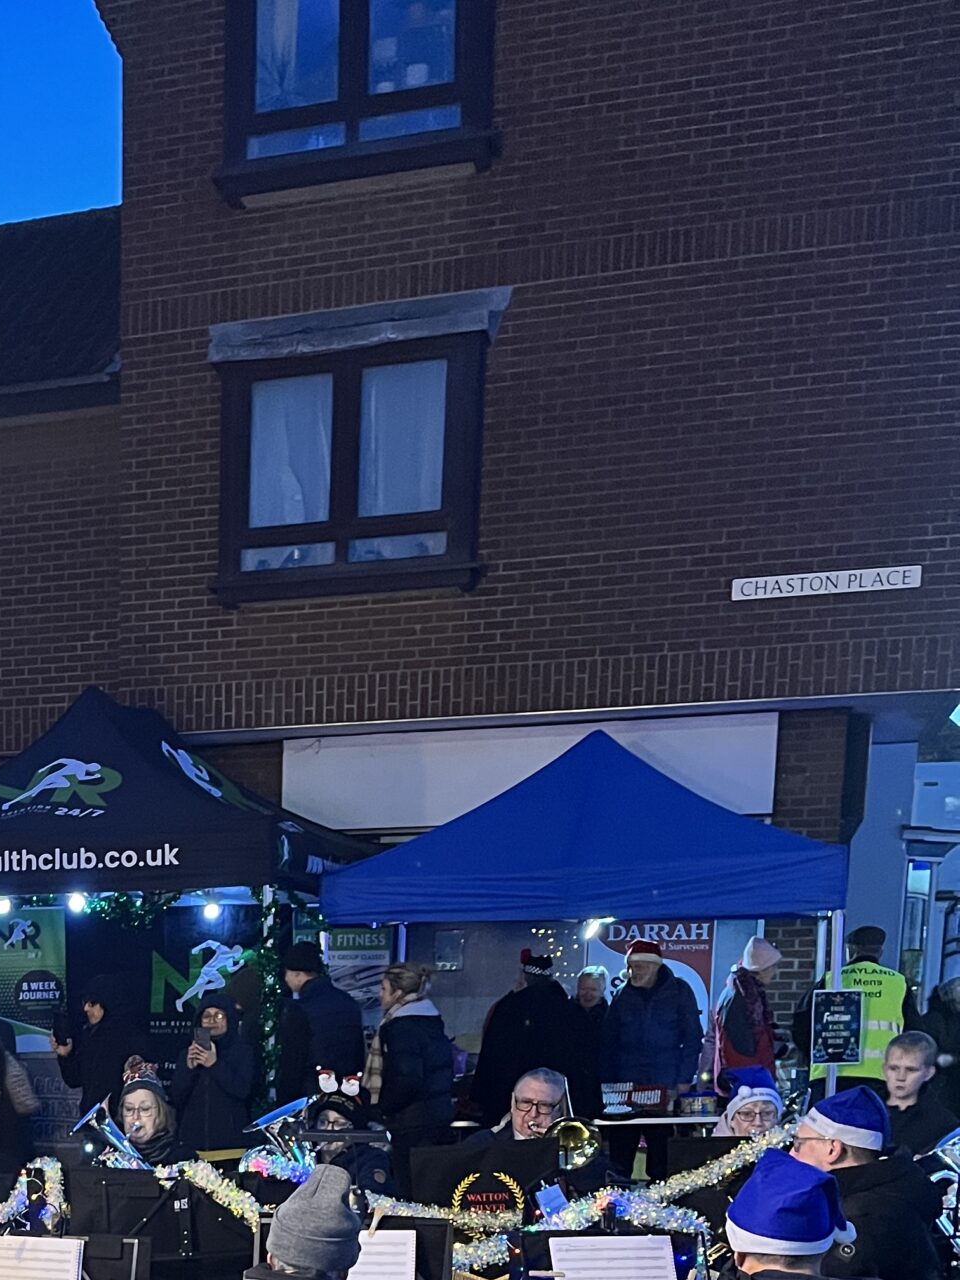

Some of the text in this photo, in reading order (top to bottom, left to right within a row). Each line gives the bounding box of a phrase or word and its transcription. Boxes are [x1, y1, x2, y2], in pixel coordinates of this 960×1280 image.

[740, 570, 912, 597] CHASTON PLACE
[54, 808, 105, 818] 24/7
[608, 923, 710, 941] DARRAH
[337, 933, 386, 947] FITNESS
[668, 942, 709, 952] Surveyors
[22, 981, 57, 991] 8 WEEK
[853, 978, 883, 986] Mens
[19, 990, 60, 1000] JOURNEY
[466, 1192, 510, 1201] WATTON
